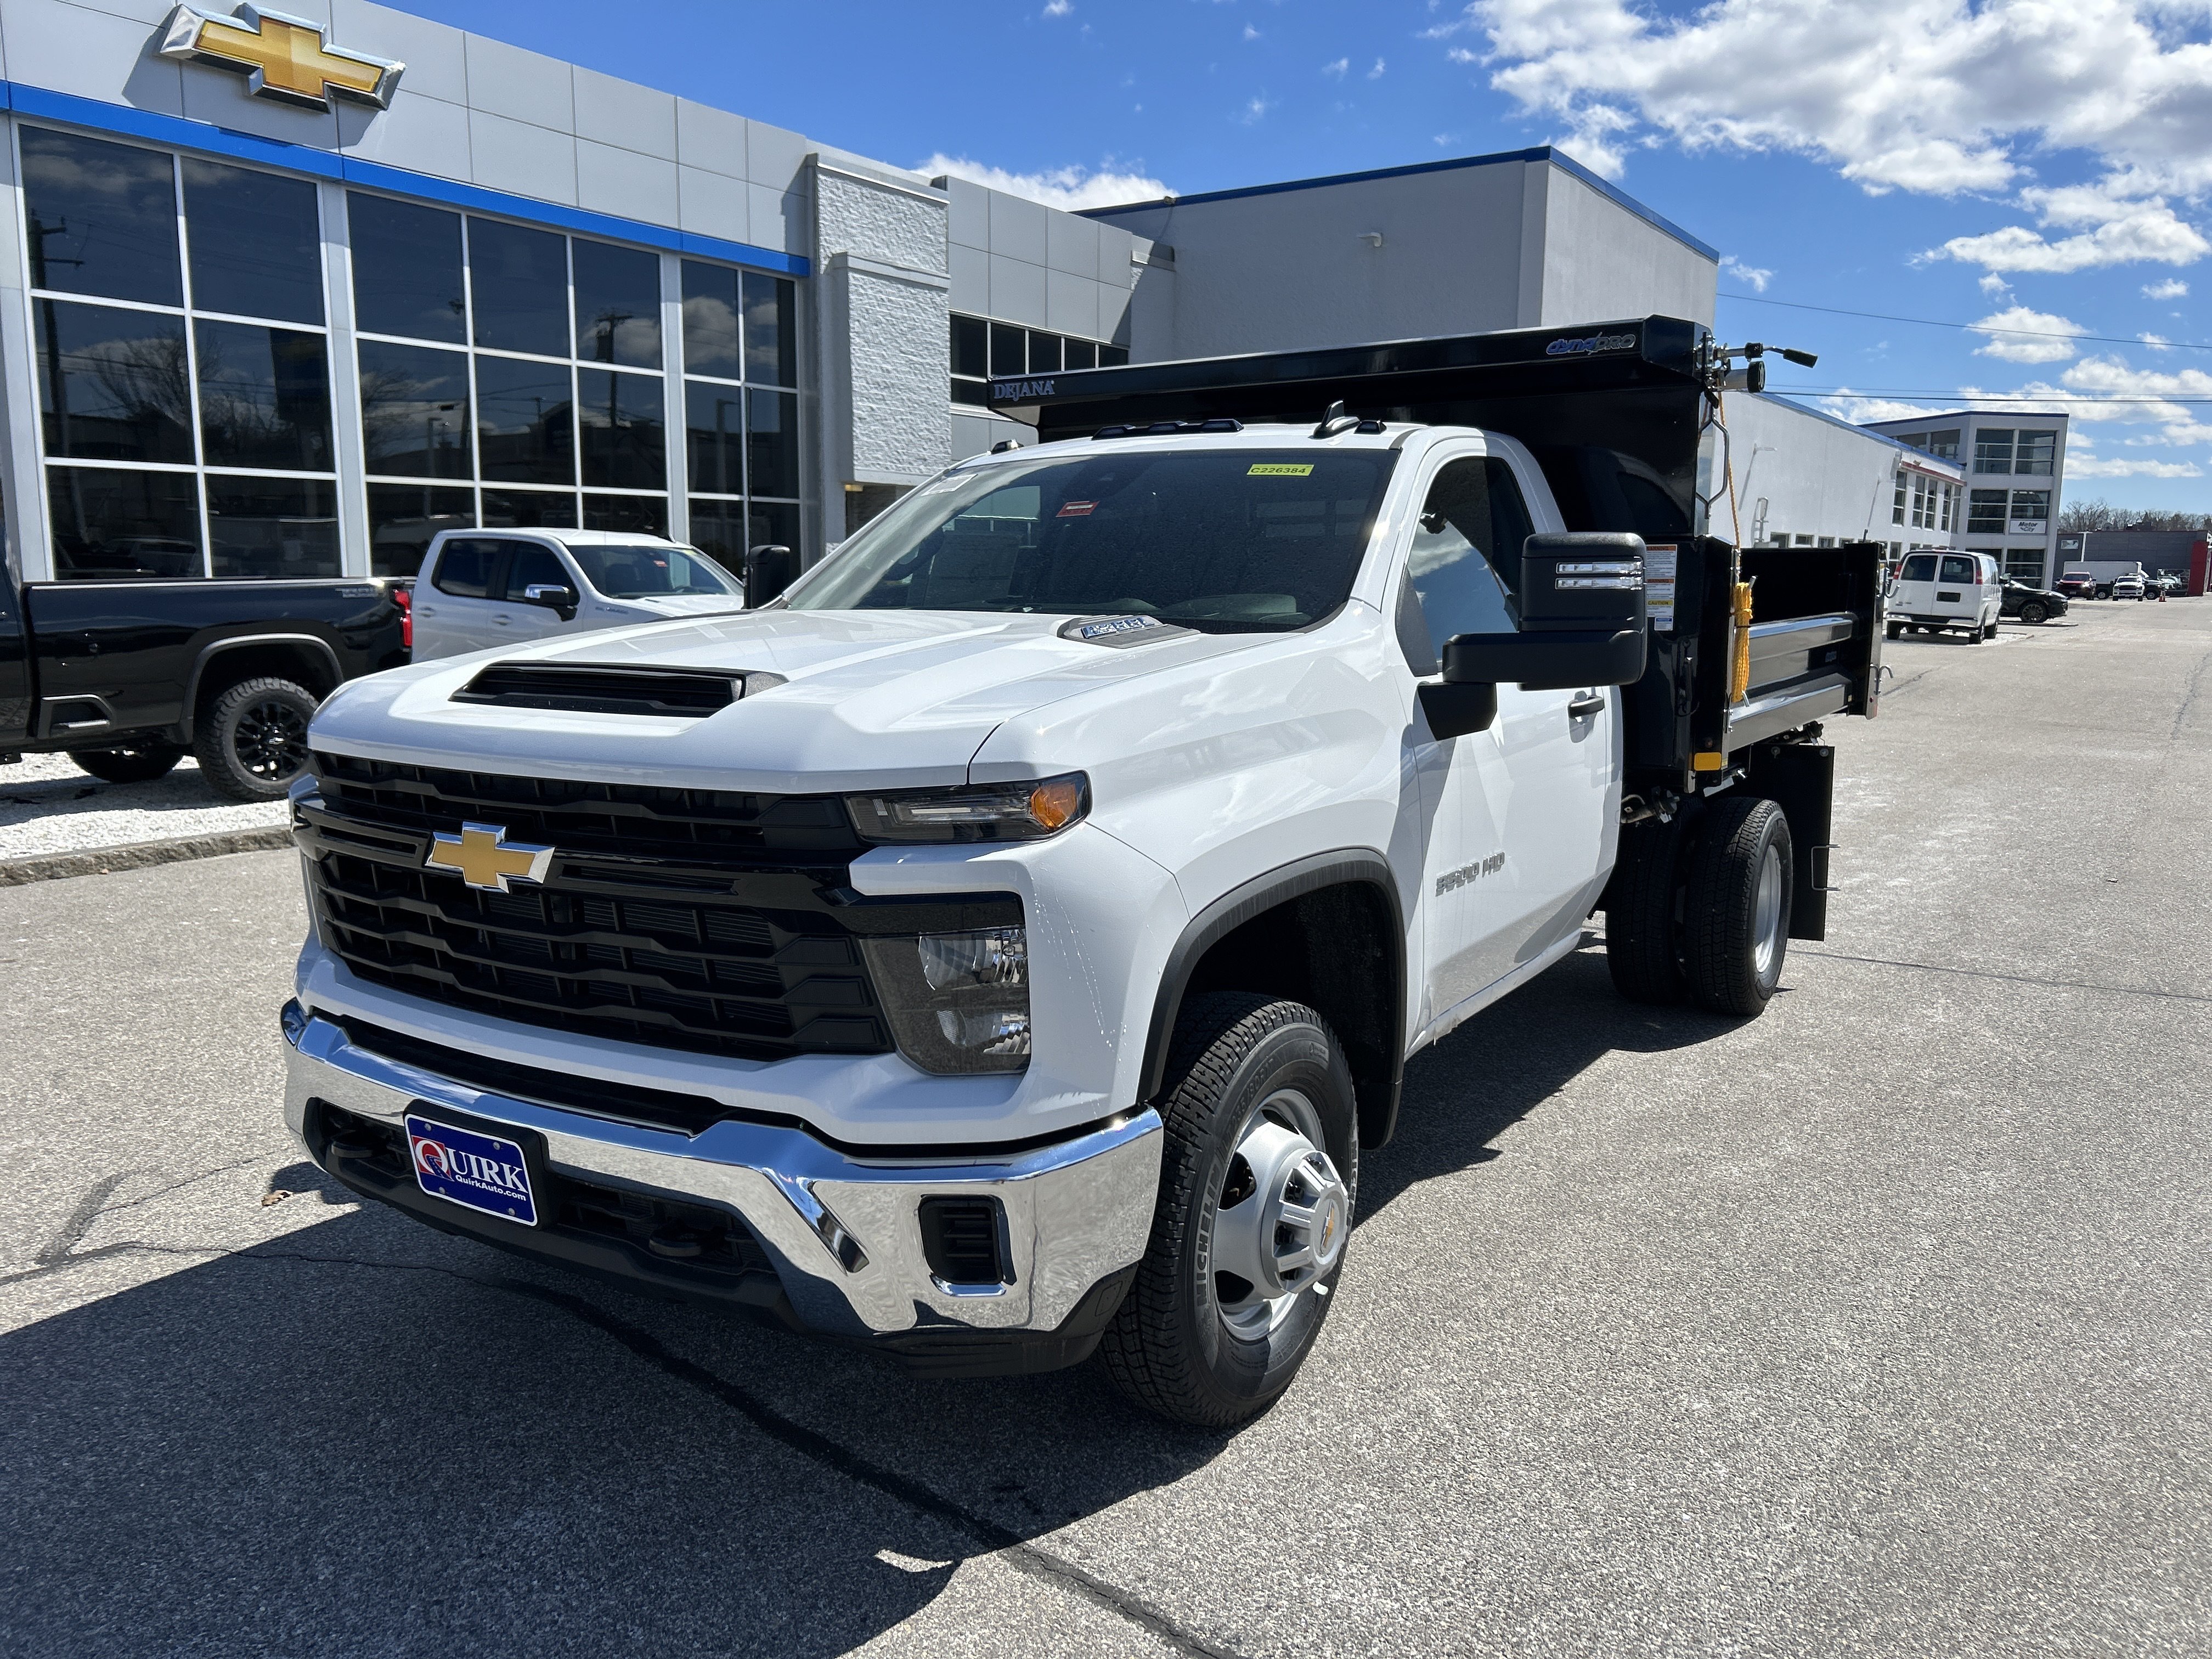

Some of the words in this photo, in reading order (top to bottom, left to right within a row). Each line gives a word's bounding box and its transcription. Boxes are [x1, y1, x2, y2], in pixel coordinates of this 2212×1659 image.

[994, 380, 1055, 402] DEJANA
[1435, 861, 1480, 896] 3500
[1482, 851, 1505, 877] HD
[415, 1139, 528, 1193] QUIRK
[455, 1174, 526, 1201] QuirkAuto.com
[1197, 1165, 1221, 1306] MICHELIN
